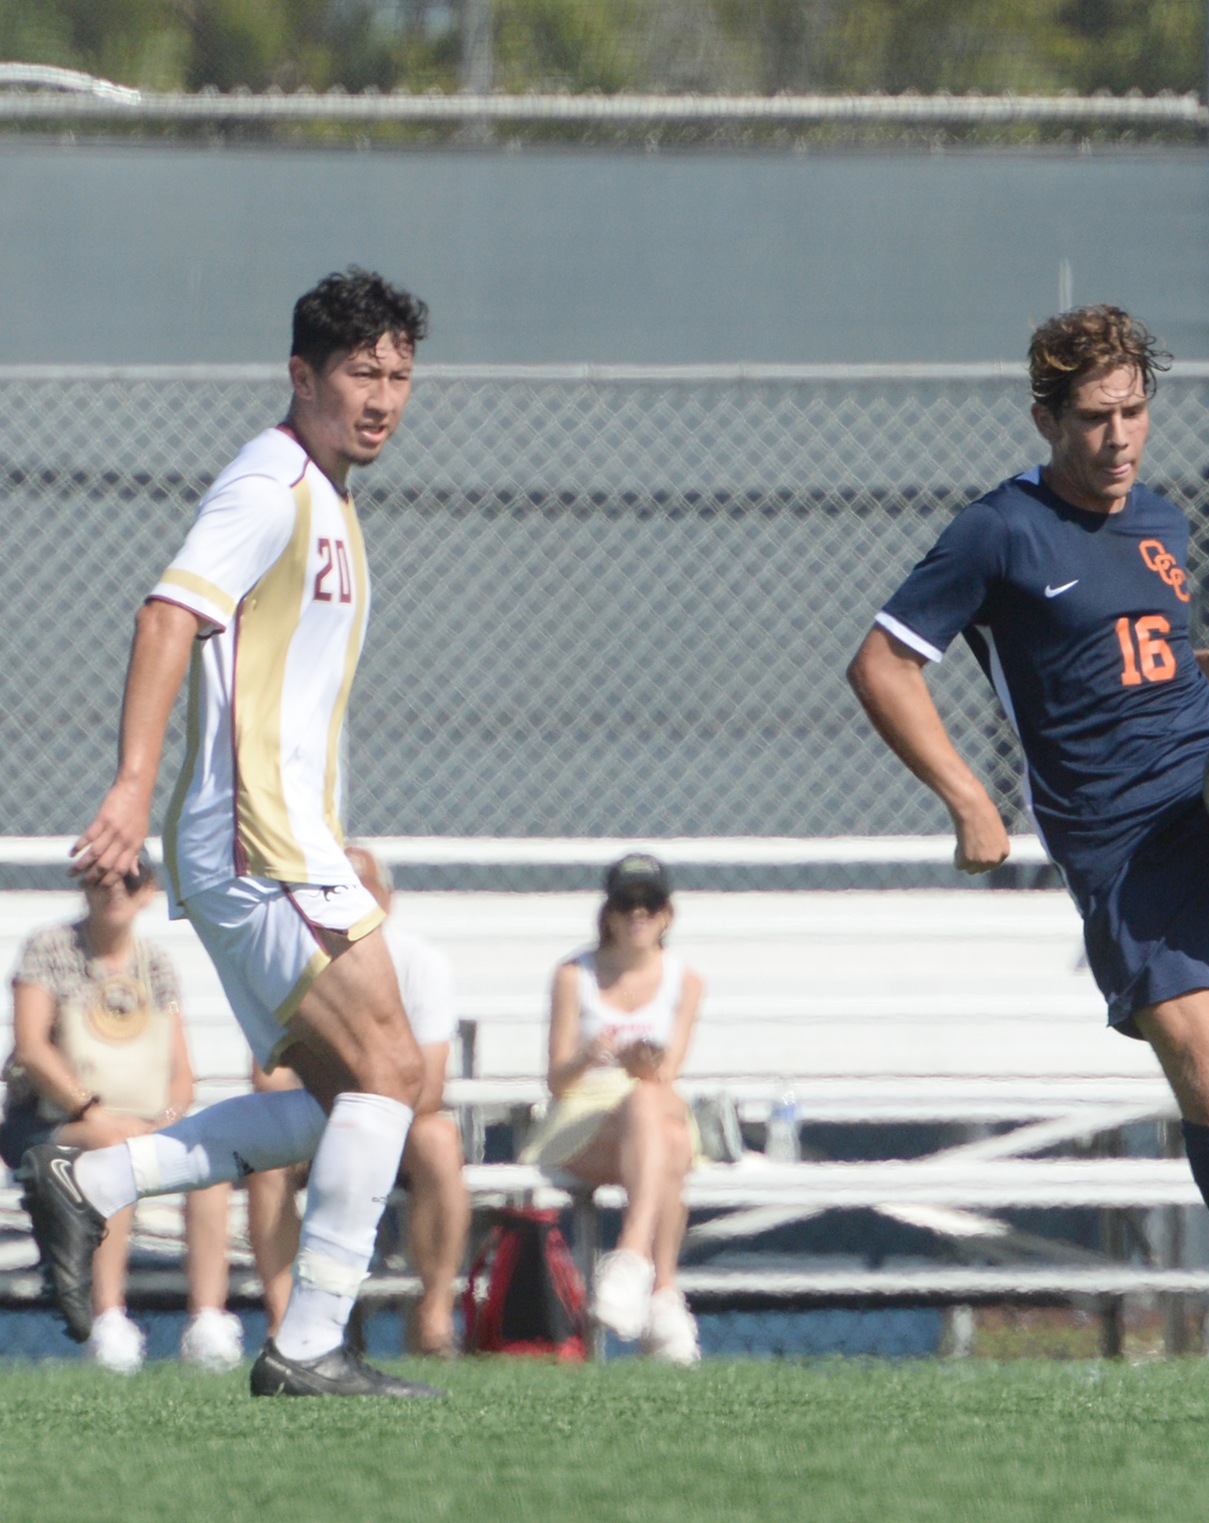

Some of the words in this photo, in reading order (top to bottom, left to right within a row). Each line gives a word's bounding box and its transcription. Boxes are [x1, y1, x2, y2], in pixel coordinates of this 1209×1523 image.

[313, 537, 352, 603] 20
[1138, 538, 1191, 602] OCC
[1115, 615, 1176, 686] 16
